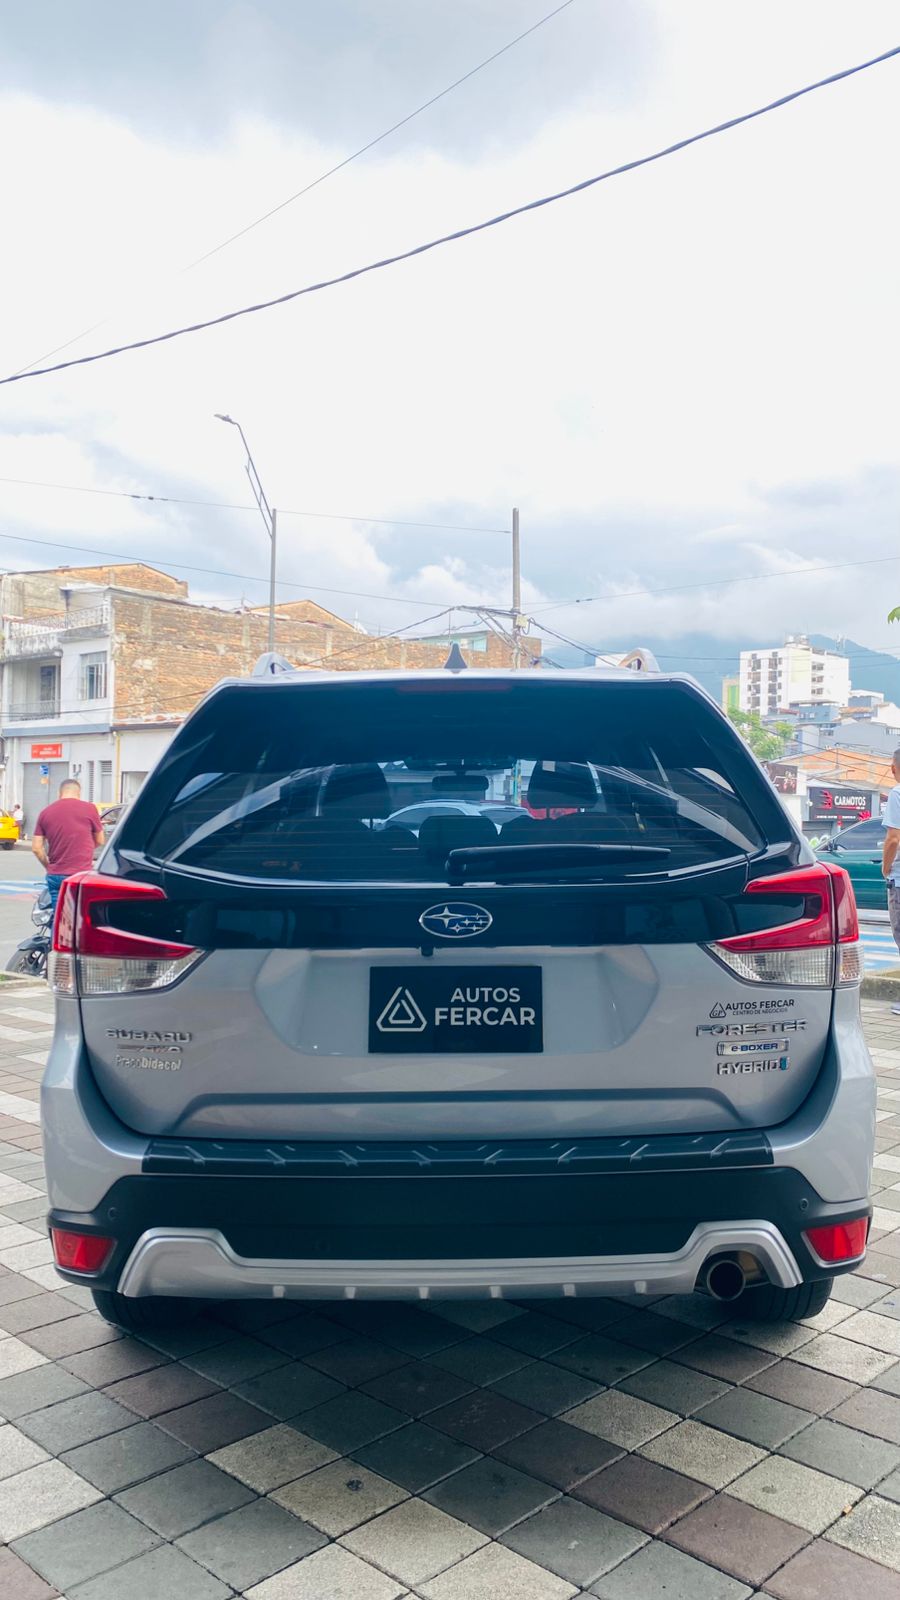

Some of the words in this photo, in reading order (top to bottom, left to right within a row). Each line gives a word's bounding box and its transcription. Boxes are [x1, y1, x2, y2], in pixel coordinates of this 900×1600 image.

[834, 796, 866, 806] CARMOTOS
[450, 987, 521, 1003] AUTOS
[725, 1001, 757, 1011] AUTOS
[759, 999, 795, 1008] FERCAR
[434, 1007, 536, 1026] FERCAR
[696, 1019, 807, 1036] FORESTER
[105, 1028, 193, 1043] SUBARU
[731, 1042, 778, 1052] e-BOXER
[717, 1059, 780, 1075] HYBRID
